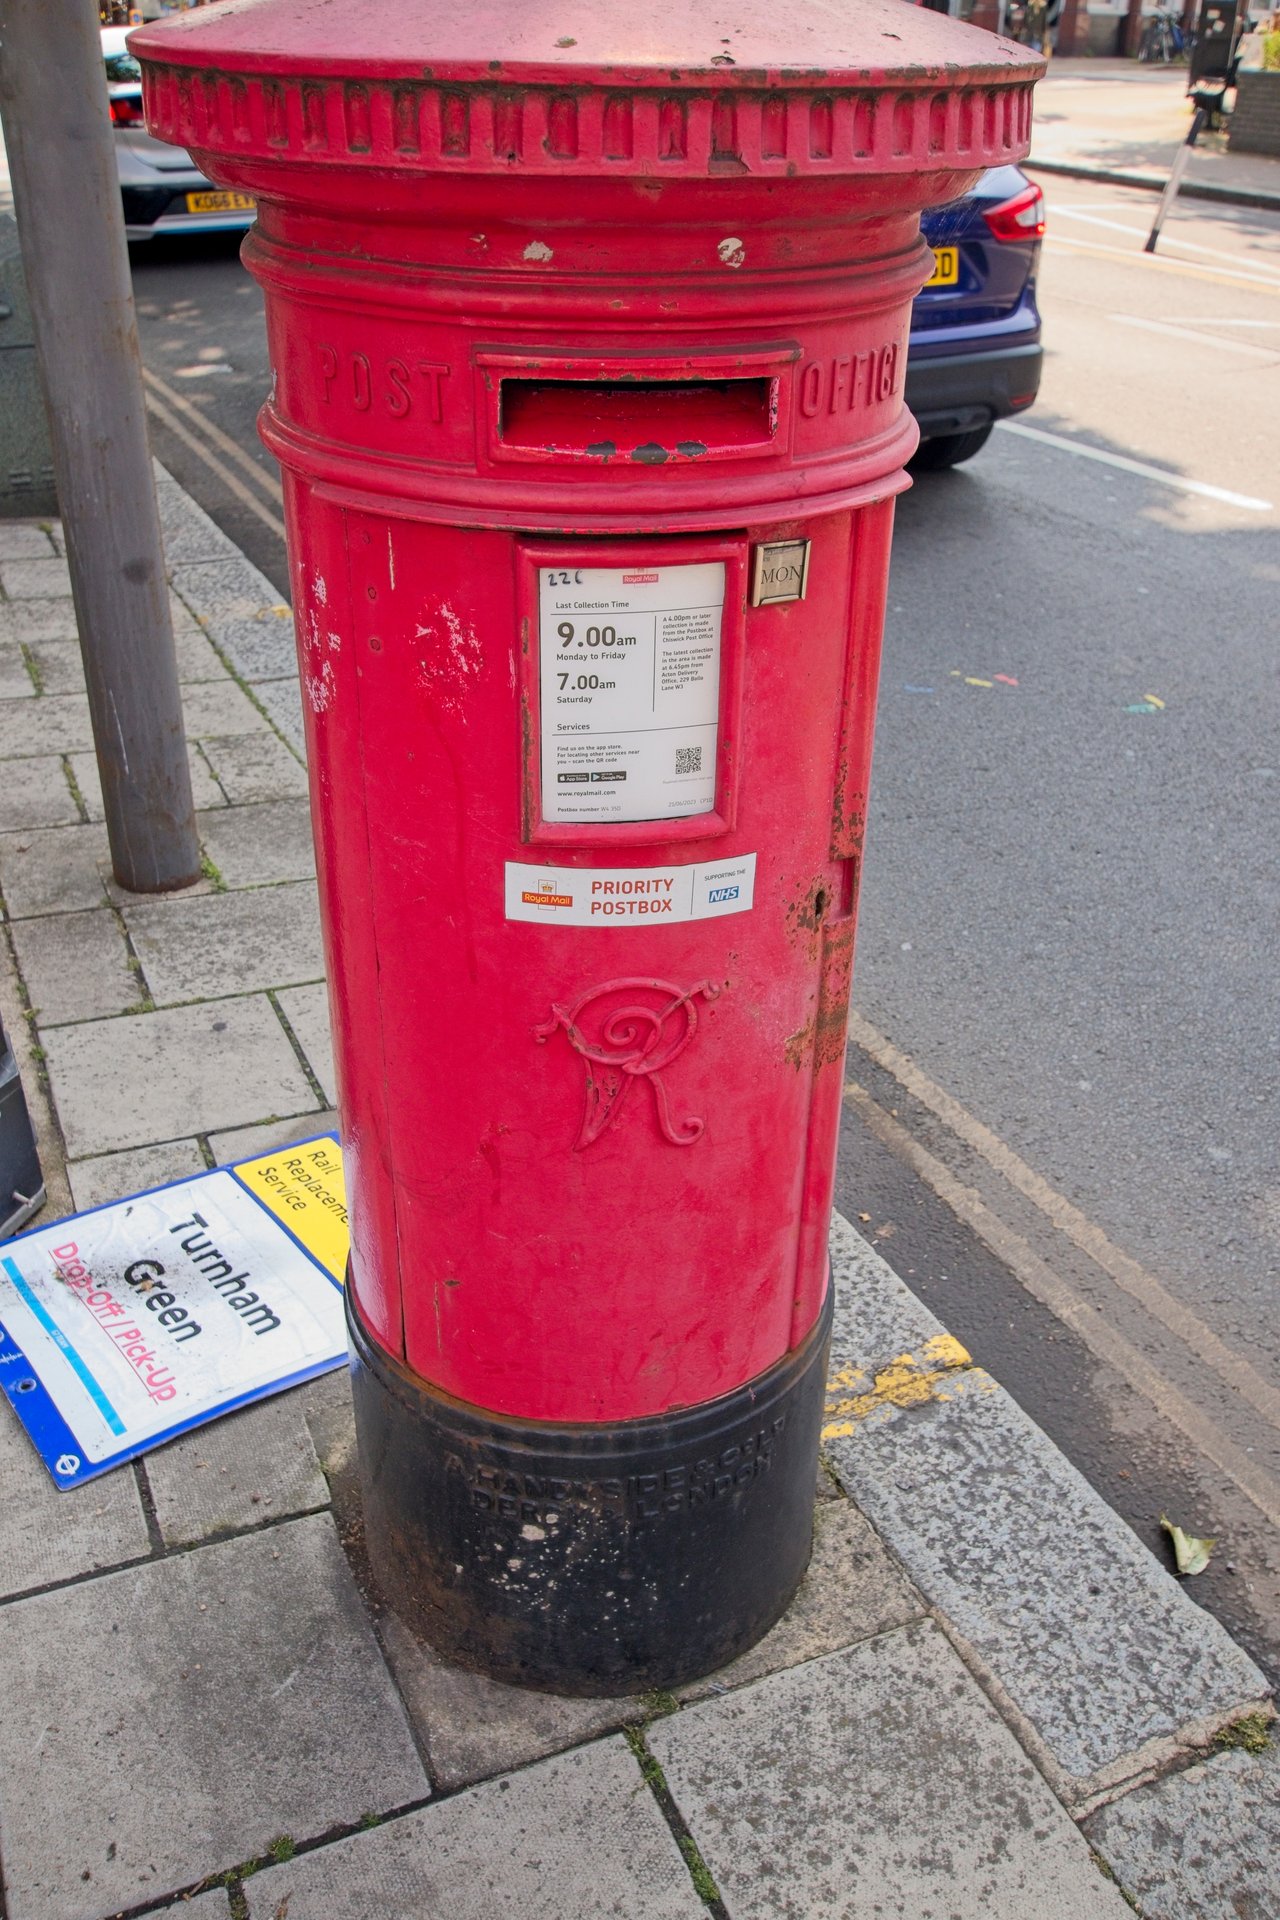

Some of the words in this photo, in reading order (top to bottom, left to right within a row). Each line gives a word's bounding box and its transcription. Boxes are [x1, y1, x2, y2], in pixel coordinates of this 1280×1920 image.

[317, 344, 450, 424] POST
[801, 340, 901, 418] OFFICE
[624, 576, 642, 584] Royal
[643, 575, 658, 583] Mail
[761, 565, 803, 584] MON
[557, 622, 637, 648] 9.00am
[557, 654, 588, 662] Monday
[601, 652, 626, 660] Friday
[557, 672, 616, 690] 7.00am
[557, 696, 593, 704] Saturday
[557, 722, 590, 731] Services
[704, 870, 736, 881] SUPPORTING
[591, 878, 674, 895] PRIORITY
[710, 886, 738, 903] NHS
[524, 893, 549, 904] Royal
[550, 896, 570, 905] Mail
[591, 898, 673, 915] POSTBOX
[307, 1150, 342, 1175] Rail
[257, 1166, 307, 1211] Service
[170, 1211, 281, 1336] Turnham
[124, 1259, 202, 1343] Green
[114, 1327, 177, 1402] Pick-Up
[636, 1454, 771, 1520] LONDON
